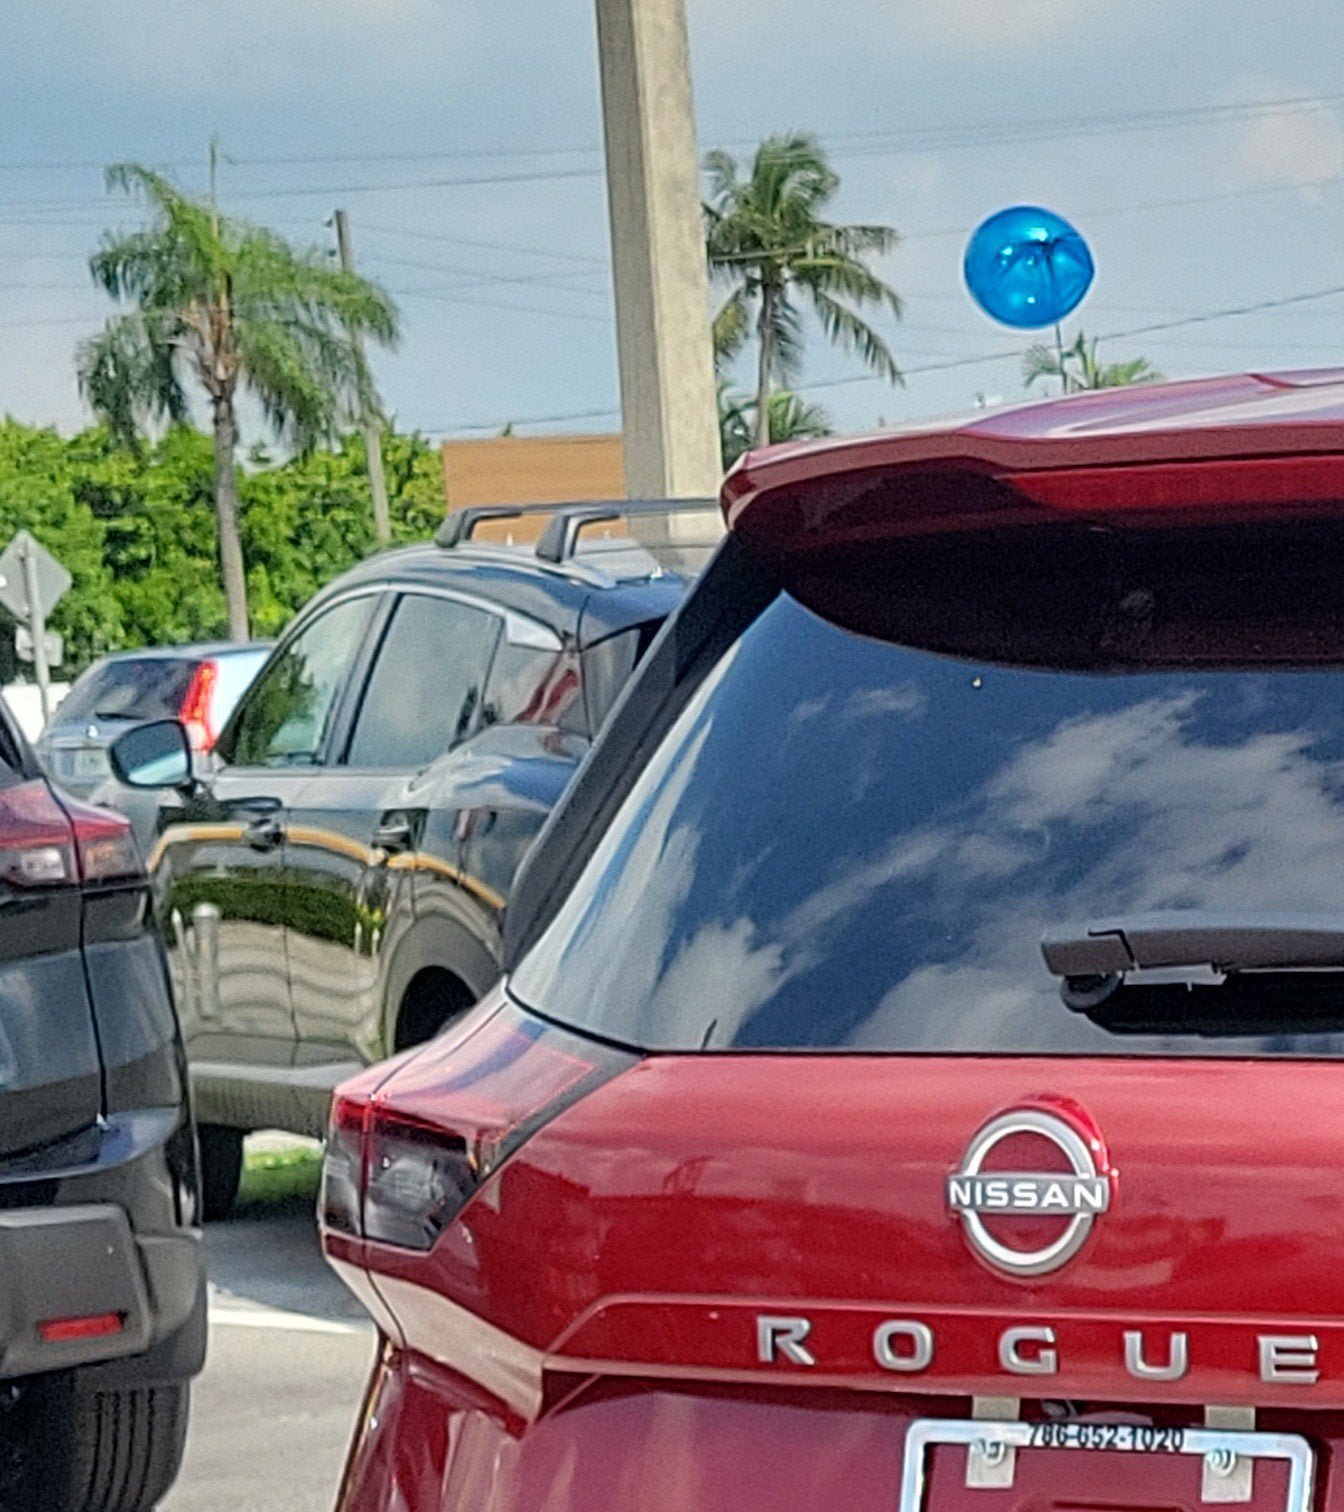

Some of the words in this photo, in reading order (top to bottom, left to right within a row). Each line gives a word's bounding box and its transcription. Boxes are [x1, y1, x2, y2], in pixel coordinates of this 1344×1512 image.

[949, 1178, 1105, 1211] NISSAN
[756, 1313, 1321, 1384] ROGUE
[1028, 1421, 1185, 1452] 786-652-1020
